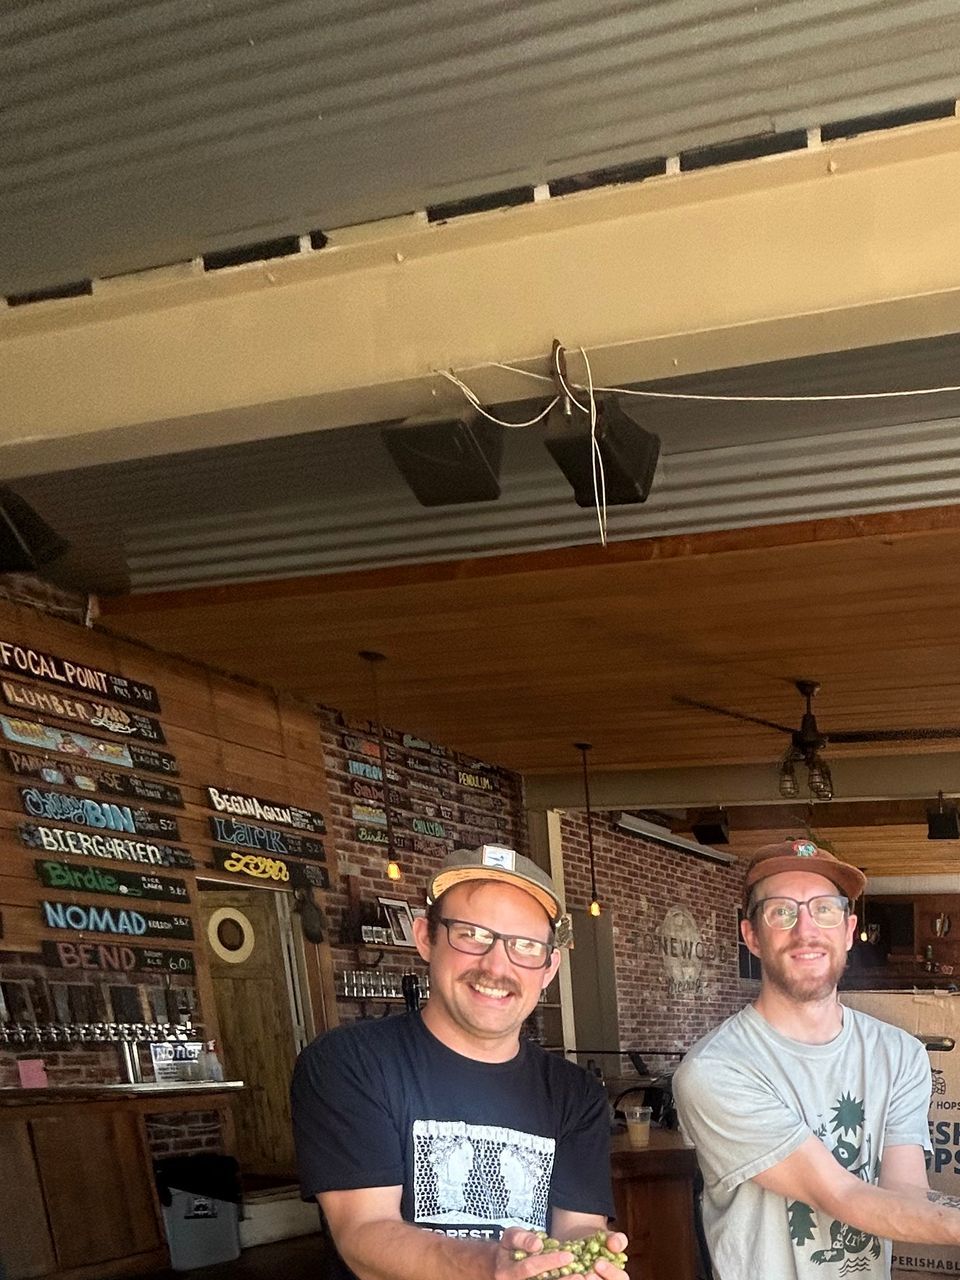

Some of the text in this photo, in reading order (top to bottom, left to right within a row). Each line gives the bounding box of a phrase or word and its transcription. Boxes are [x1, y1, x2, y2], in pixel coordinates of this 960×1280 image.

[0, 641, 108, 694] FOCAL POINT
[6, 683, 131, 725] LUMBER YARD
[84, 799, 137, 833] BIN
[208, 787, 256, 816] BEGIN
[252, 797, 292, 824] AGAIN
[43, 862, 119, 892] Birdie
[44, 900, 147, 936] NOMAD
[55, 941, 137, 971] BEND
